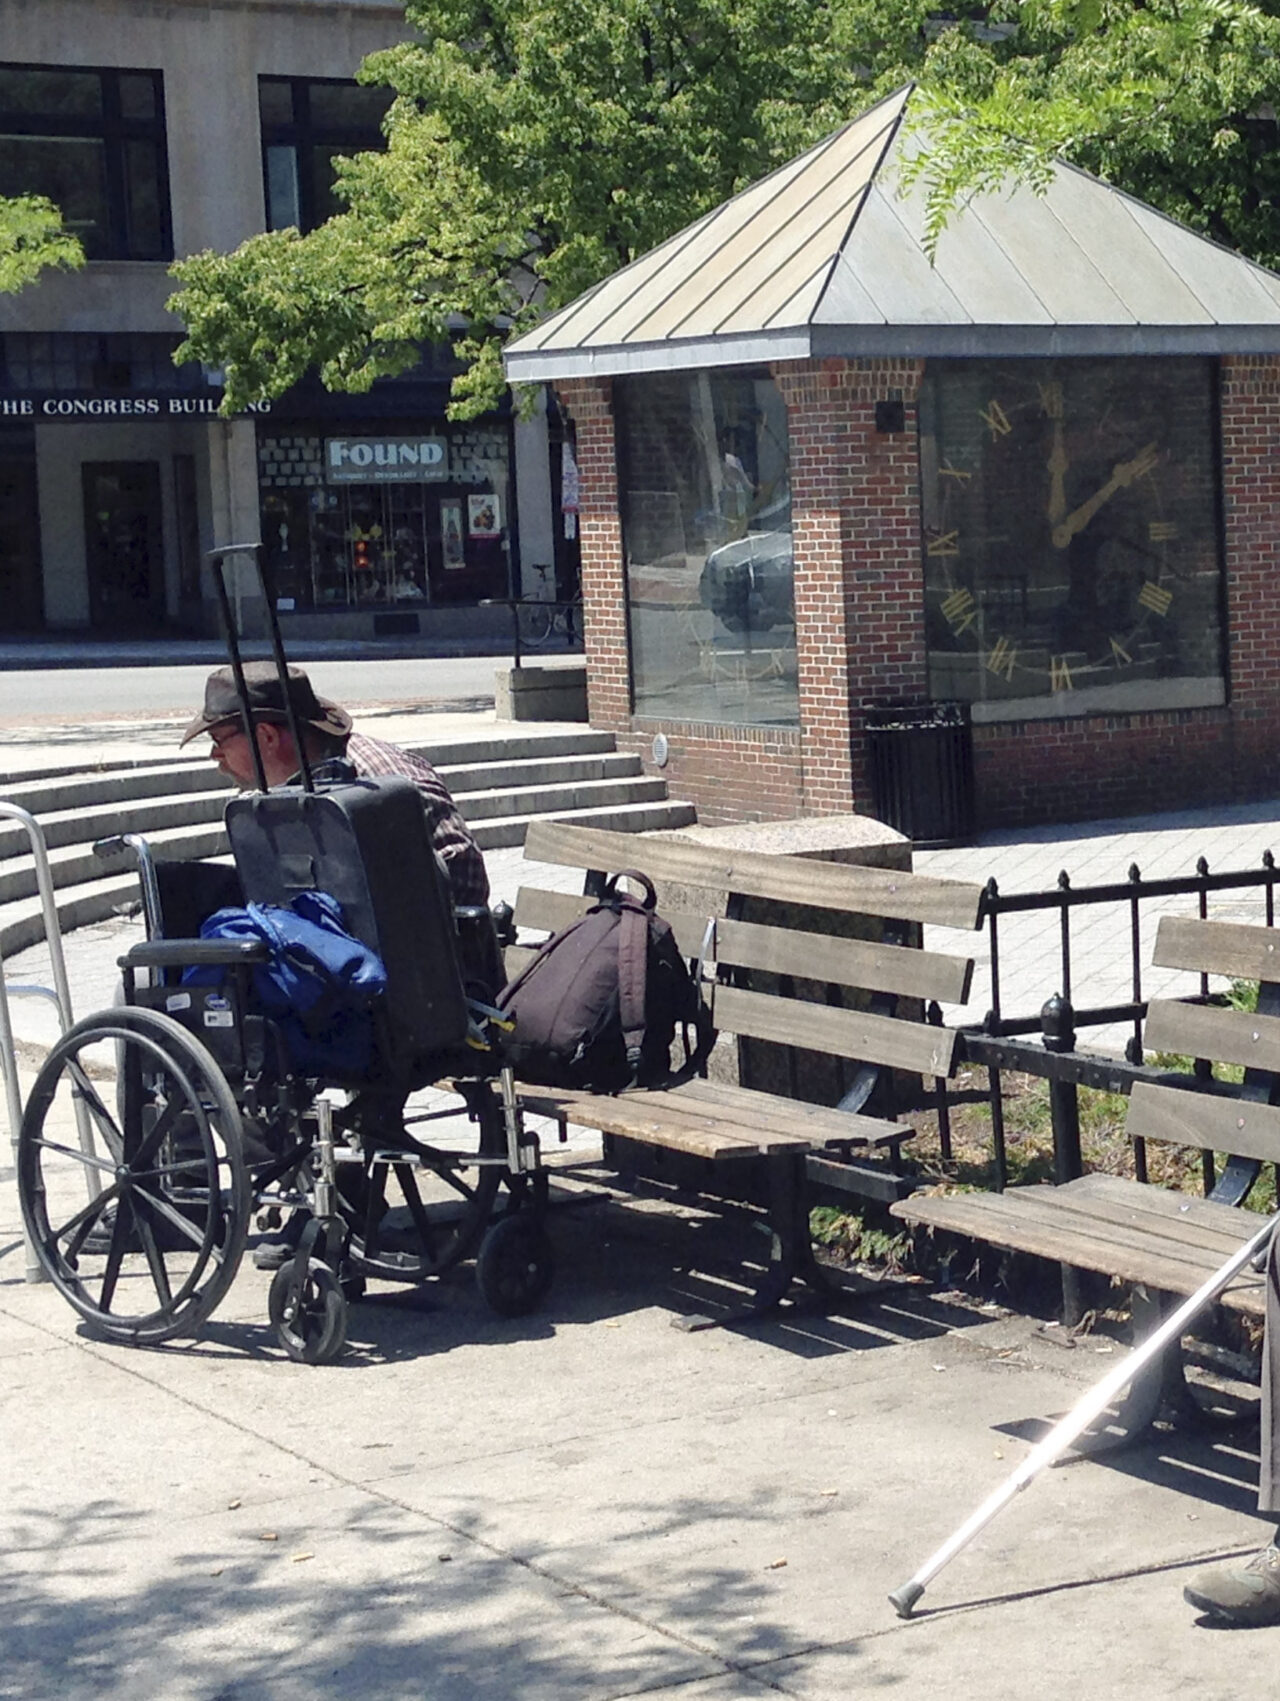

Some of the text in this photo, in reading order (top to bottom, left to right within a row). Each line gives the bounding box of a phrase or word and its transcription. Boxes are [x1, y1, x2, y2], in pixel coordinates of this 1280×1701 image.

[0, 398, 272, 415] HE CONGRESS BUILNG
[329, 440, 444, 467] FOUND
